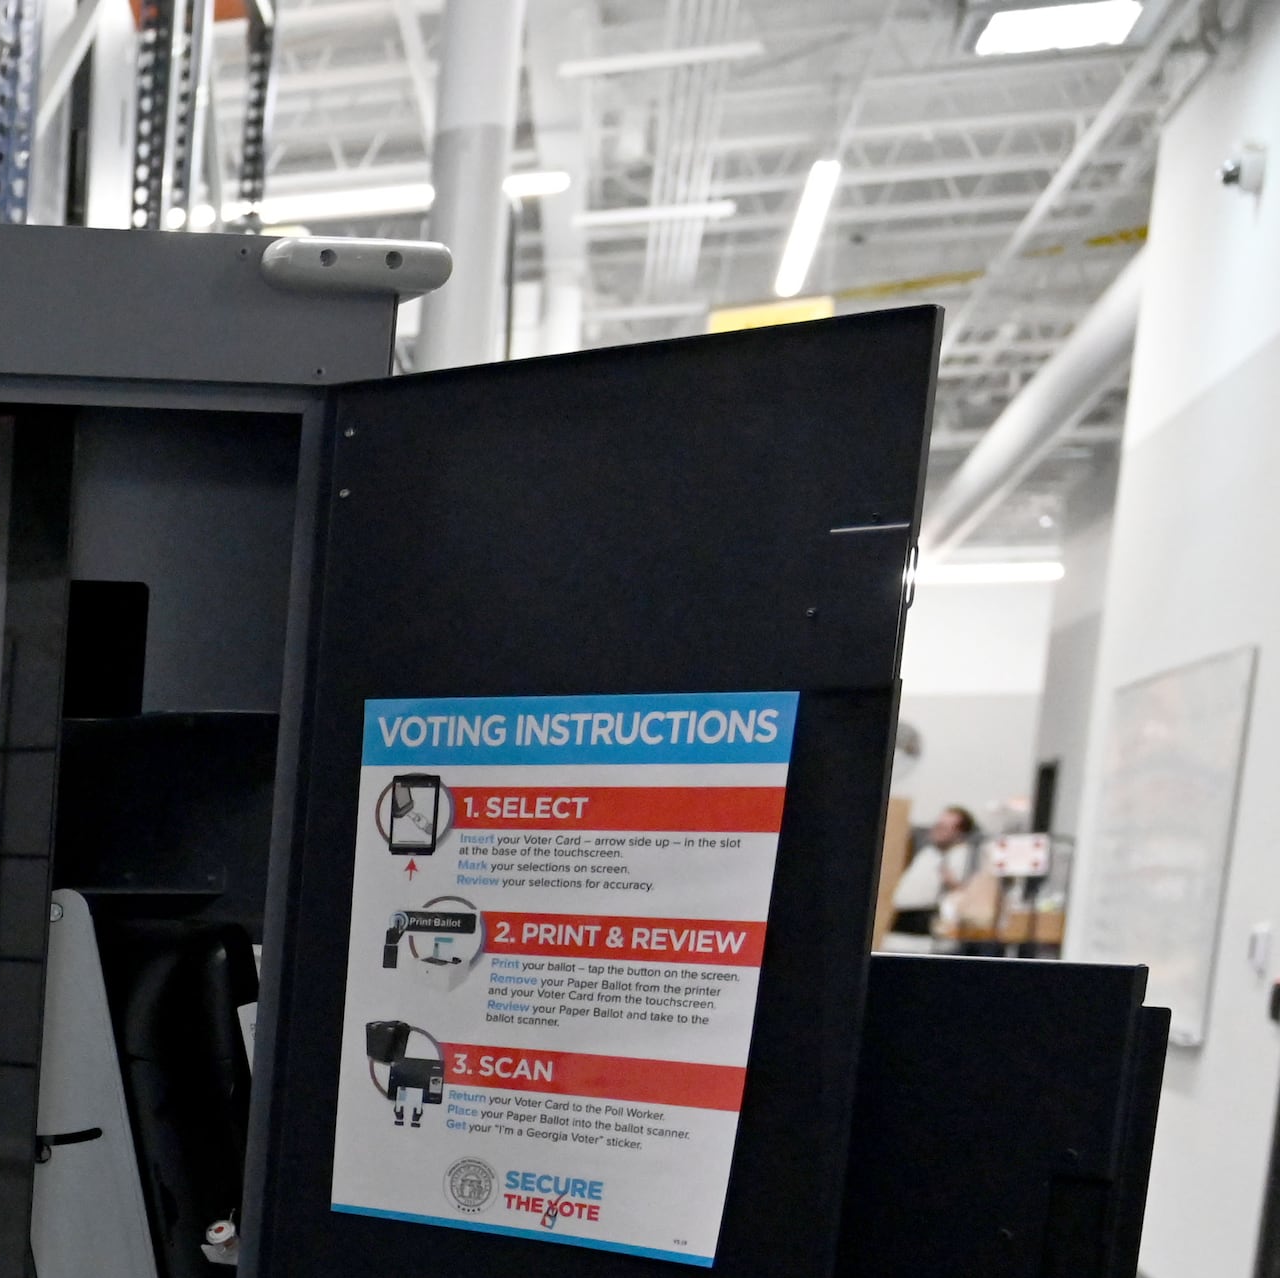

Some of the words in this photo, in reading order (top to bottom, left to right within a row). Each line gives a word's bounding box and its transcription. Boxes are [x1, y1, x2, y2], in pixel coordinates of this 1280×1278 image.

[377, 714, 507, 747] VOTING
[515, 708, 779, 746] INSTRUCTIONS
[463, 796, 479, 818] 1.
[485, 796, 589, 819] SELECT
[458, 846, 469, 855] at
[471, 846, 488, 855] the
[491, 846, 517, 856] base
[519, 846, 532, 856] of
[533, 847, 551, 857] the
[458, 859, 488, 870] Mark
[490, 863, 515, 873] your
[516, 861, 571, 873] selections
[573, 864, 588, 873] on
[456, 874, 499, 887] Review
[502, 878, 526, 888] your
[528, 877, 582, 888] selections
[585, 878, 601, 889] for
[409, 916, 432, 926] Print
[433, 917, 461, 927] Ballot
[494, 921, 516, 943] 2.
[521, 922, 602, 947] PRINT
[605, 926, 624, 948] &
[631, 927, 747, 954] REVIEW
[489, 972, 538, 985] Remove
[540, 978, 564, 988] your
[567, 978, 598, 990] Paper
[601, 980, 632, 992] Ballot
[635, 982, 660, 993] from
[663, 984, 682, 994] the
[684, 986, 721, 998] printer
[485, 1012, 514, 1023] ballot
[487, 999, 530, 1012] Review
[532, 1005, 556, 1015] your
[559, 1004, 590, 1017] Paper
[593, 1007, 623, 1019] Ballot
[626, 1010, 647, 1020] and
[650, 1011, 674, 1023] take
[677, 1014, 688, 1024] to
[691, 1014, 709, 1025] the
[452, 1053, 472, 1075] 3.
[478, 1055, 553, 1082] SCAN
[448, 1090, 487, 1103] Return
[488, 1095, 512, 1106] your
[514, 1096, 542, 1108] Voter
[544, 1099, 570, 1111] Card
[572, 1103, 583, 1112] to
[585, 1103, 602, 1114] the
[604, 1104, 624, 1116] Poll
[446, 1119, 467, 1130] Get
[468, 1124, 492, 1134] your
[516, 1128, 523, 1136] a
[526, 1127, 568, 1143] Georgia
[447, 1104, 478, 1117] Place
[480, 1110, 504, 1119] your
[506, 1110, 537, 1123] Paper
[539, 1113, 570, 1126] Ballot
[572, 1118, 592, 1129] into
[594, 1119, 612, 1131] the
[614, 1121, 644, 1135] ballot
[504, 1170, 603, 1200] SECURE
[504, 1193, 543, 1214] THE
